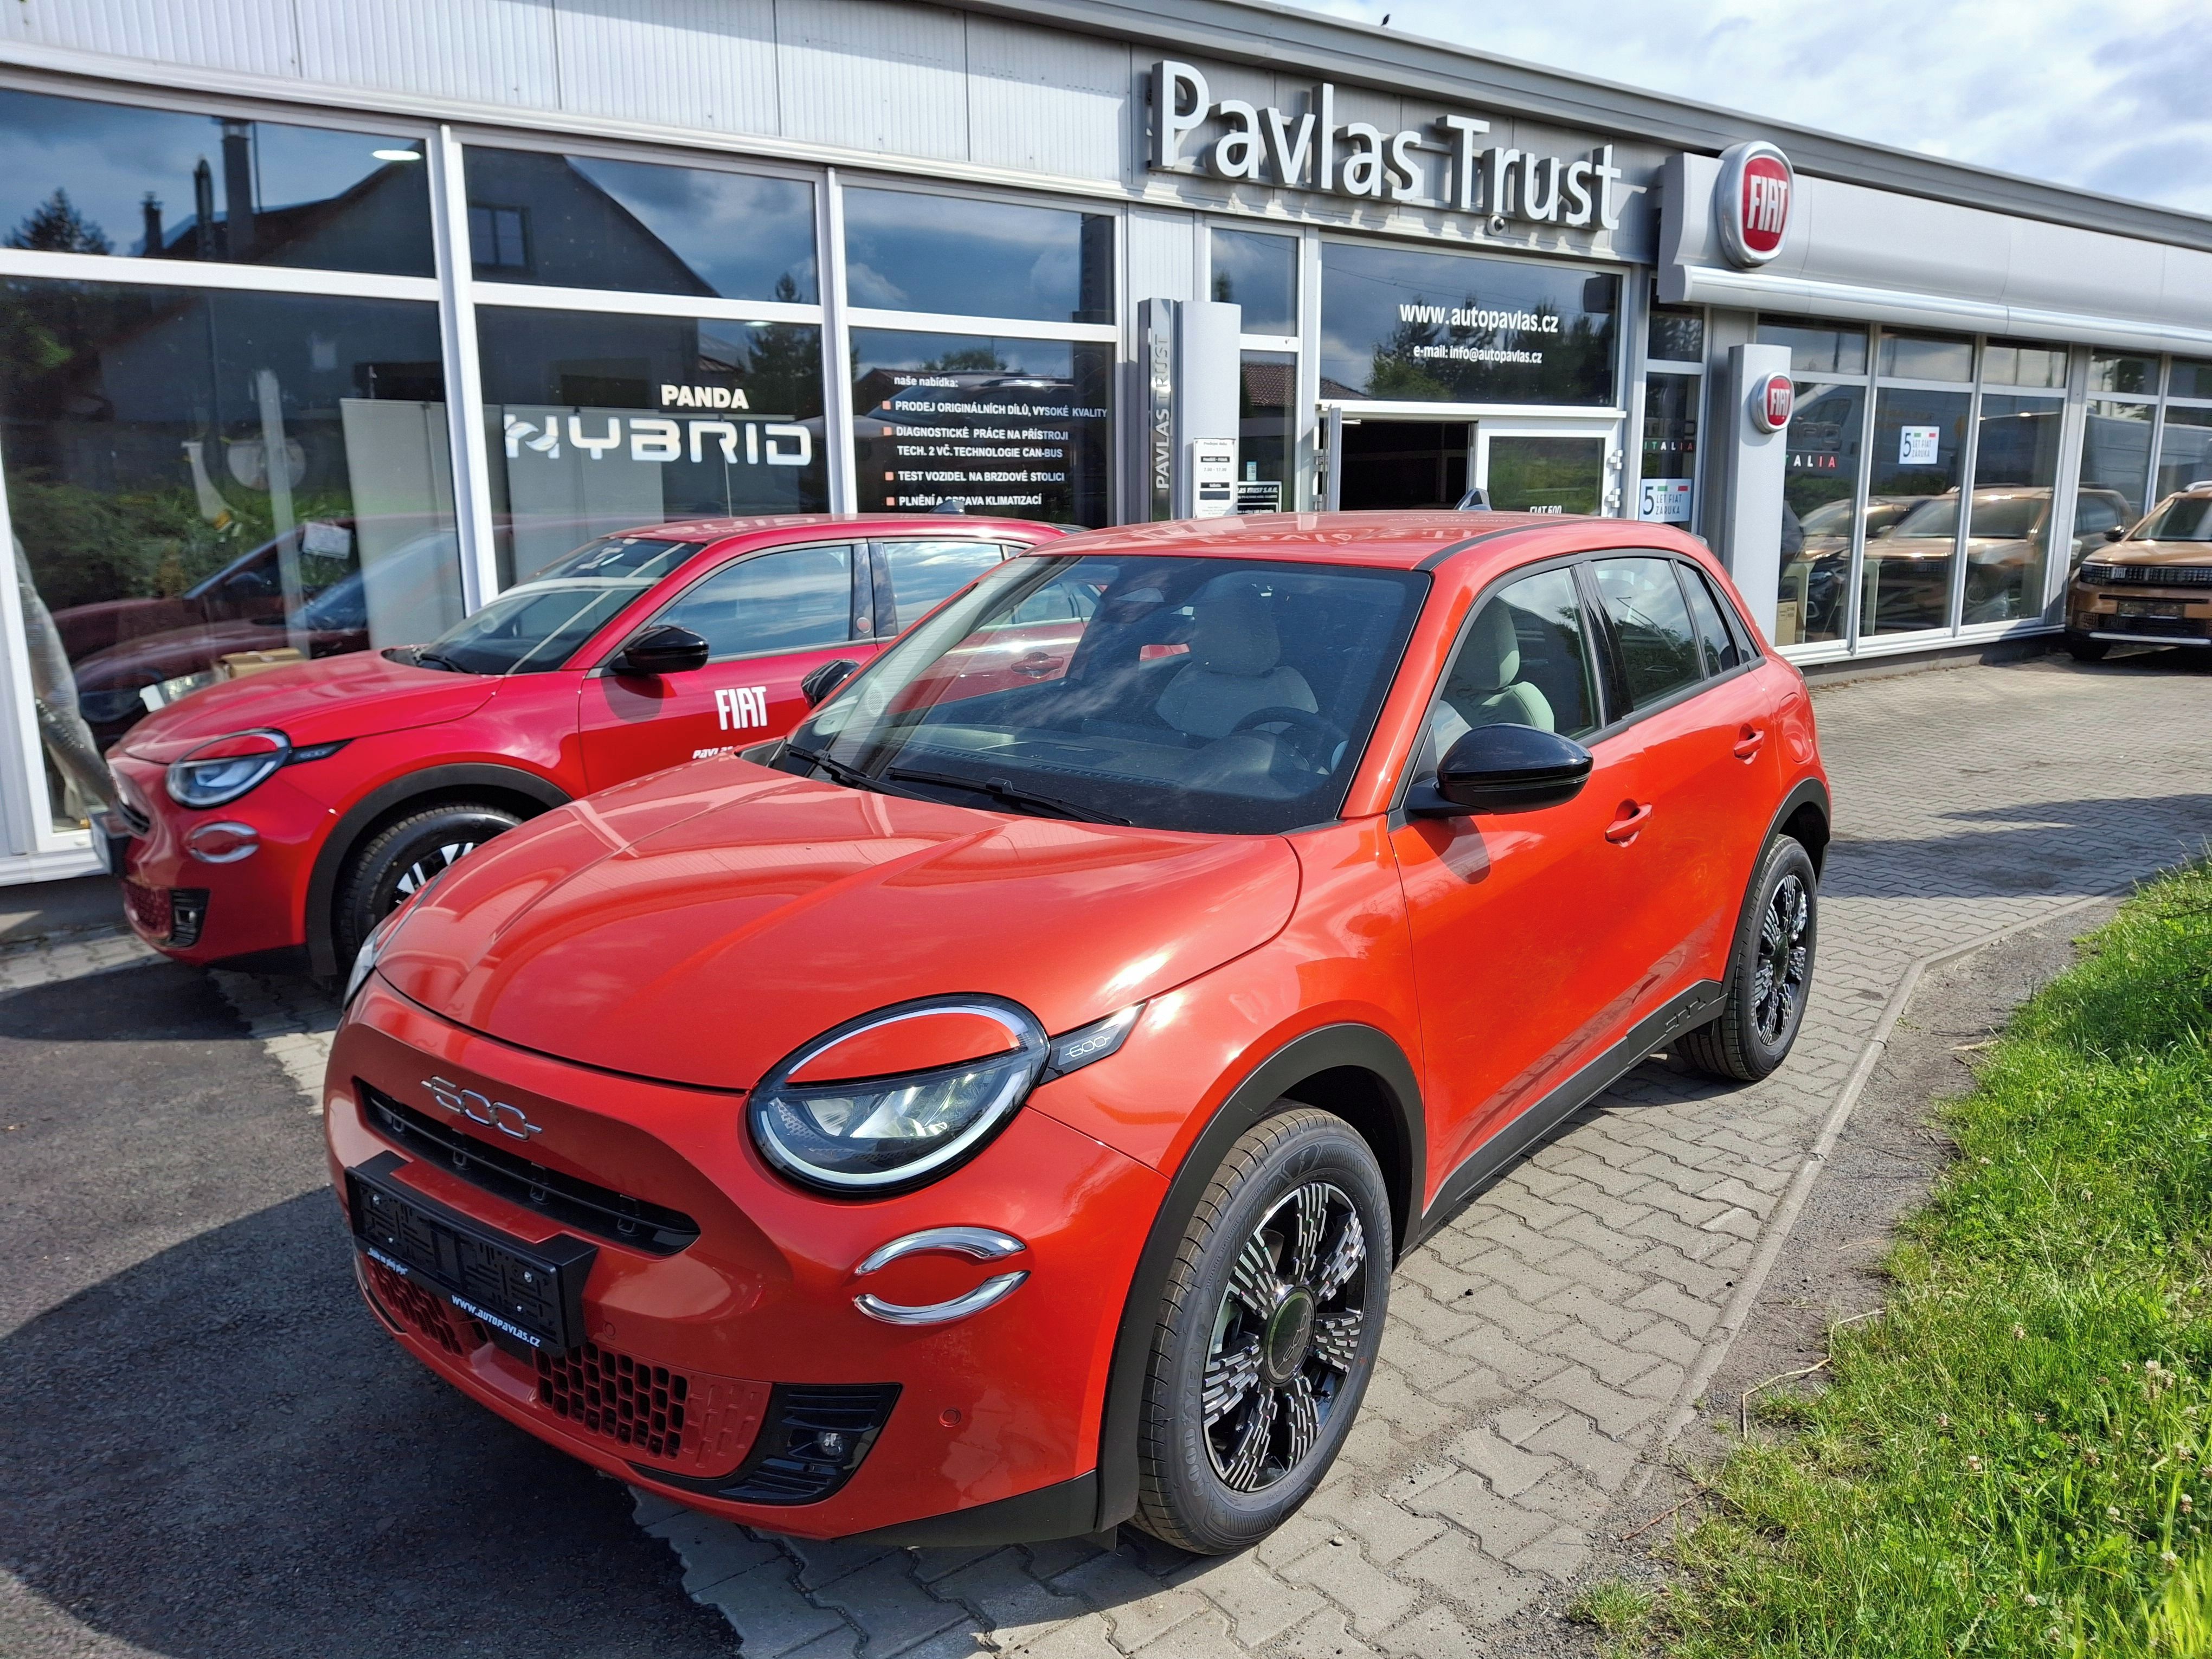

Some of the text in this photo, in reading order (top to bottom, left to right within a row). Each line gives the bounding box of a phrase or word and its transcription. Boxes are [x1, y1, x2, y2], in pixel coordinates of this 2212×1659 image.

[1156, 60, 1622, 230] Pavlas Trust
[1747, 174, 1787, 233] FIAT
[1399, 304, 1559, 333] www.autopavlas.cz
[1413, 345, 1542, 364] e-mail: info@autopavlas.cz
[894, 375, 959, 388] naše nabídka:
[661, 384, 749, 409] PANDA
[1770, 388, 1790, 416] FIAT
[896, 401, 936, 412] PRODEJ
[937, 401, 1006, 415] ORIGINÁLNÍCH
[1032, 404, 1070, 417] VYSOKÉ
[1072, 407, 1107, 417] KVALITY
[1155, 334, 1169, 489] PAVLAS TRUST
[504, 414, 812, 466] HYBRID
[896, 426, 1069, 440] DIAGNOSTICKÉ PRÁCE NA PŘÍSTROJI
[897, 445, 927, 456] TECH.
[929, 446, 935, 456] 2
[953, 446, 1020, 457] TECHNOLOGIE
[1023, 448, 1063, 458] CAN-BUS
[1644, 441, 1694, 451] ITALIA
[1903, 433, 1912, 457] 5
[898, 470, 1065, 482] TEST VOZIDEL NA BRZDOVÉ STOLICI
[936, 497, 944, 506] A
[986, 493, 1042, 505] KLIMATIZACÍ
[1643, 486, 1654, 515] 5
[1656, 494, 1682, 504] LET FIAT
[1656, 504, 1680, 515] ZÁRUKA
[715, 686, 768, 730] FIAT
[1066, 1036, 1110, 1057] 600
[421, 1075, 542, 1141] 600
